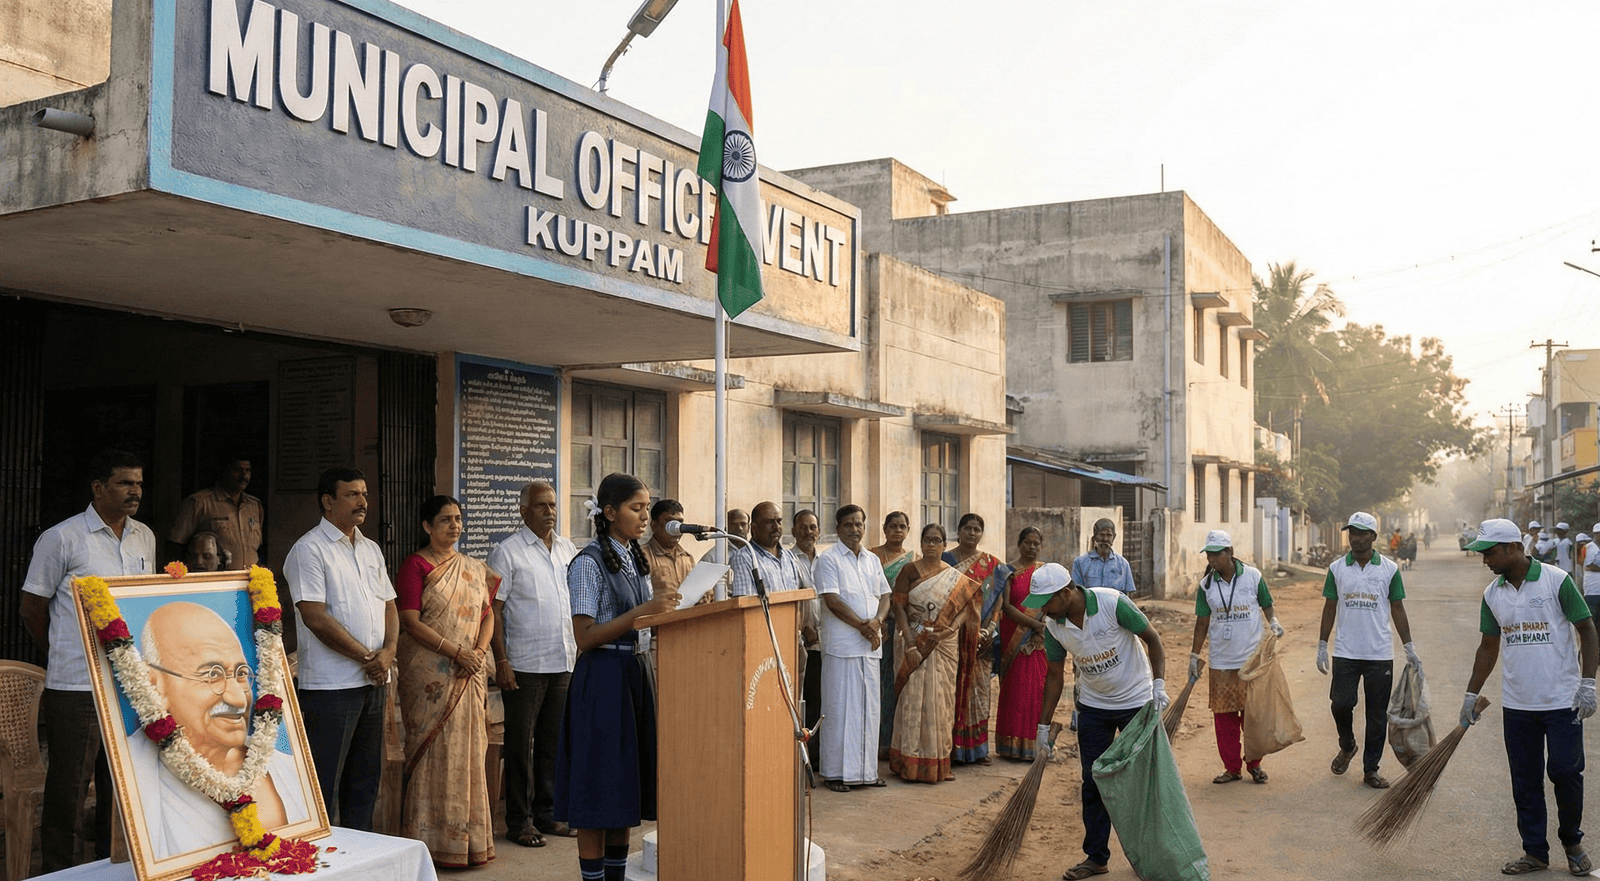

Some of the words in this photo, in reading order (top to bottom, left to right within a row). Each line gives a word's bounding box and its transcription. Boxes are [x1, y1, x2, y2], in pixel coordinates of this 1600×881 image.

[209, 0, 564, 200] MUNICIPAL
[578, 131, 719, 245] OFFICE
[761, 199, 846, 286] VENT
[526, 205, 684, 284] KUPPAM
[1523, 632, 1550, 642] BHARAT
